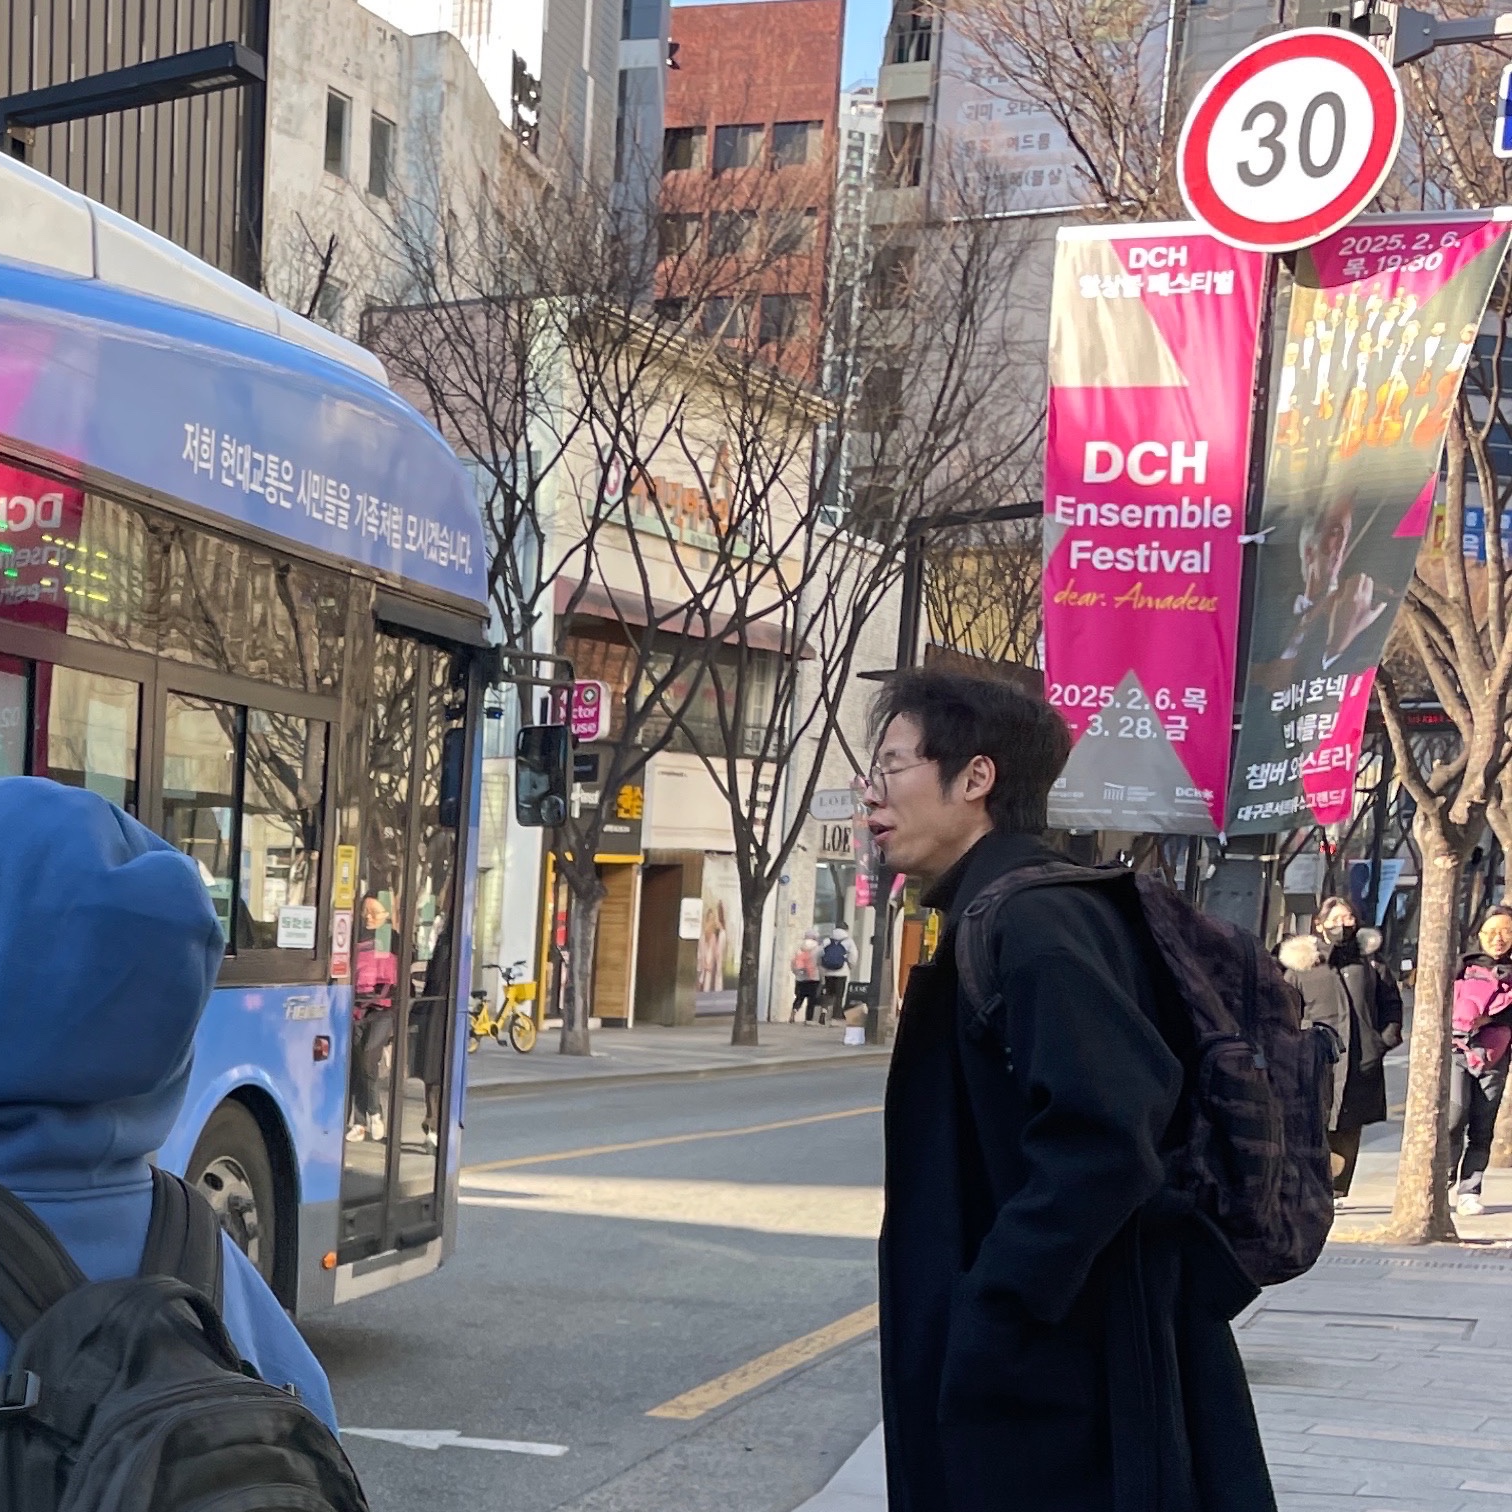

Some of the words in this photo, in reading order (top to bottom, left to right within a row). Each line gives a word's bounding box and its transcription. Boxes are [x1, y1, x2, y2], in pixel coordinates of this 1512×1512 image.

[1236, 91, 1347, 189] 30
[1129, 246, 1187, 268] DCH
[1338, 233, 1406, 257] 2025.
[1411, 232, 1434, 251] 2.
[1440, 231, 1461, 248] 6.
[1376, 252, 1444, 274] 19:30
[1147, 269, 1235, 296] 페스티벌
[1082, 440, 1208, 486] DCH
[182, 422, 215, 481] 저희
[220, 434, 294, 509] 현대교통은
[297, 469, 351, 531] 시민들을
[354, 492, 404, 550] 가족처럼
[405, 513, 473, 575] 모시겠습니다.
[1054, 496, 1232, 530] Ensemble
[1068, 539, 1212, 575] Festival
[1113, 577, 1217, 612] Amadeus
[1048, 683, 1121, 710] 2025.
[1126, 687, 1150, 710] 2.
[1154, 687, 1176, 711] 6.
[1181, 687, 1208, 715] 목
[1086, 715, 1110, 738] 3.
[1118, 715, 1158, 739] 28.
[1164, 716, 1189, 743] 금
[1245, 758, 1289, 791] 챔버
